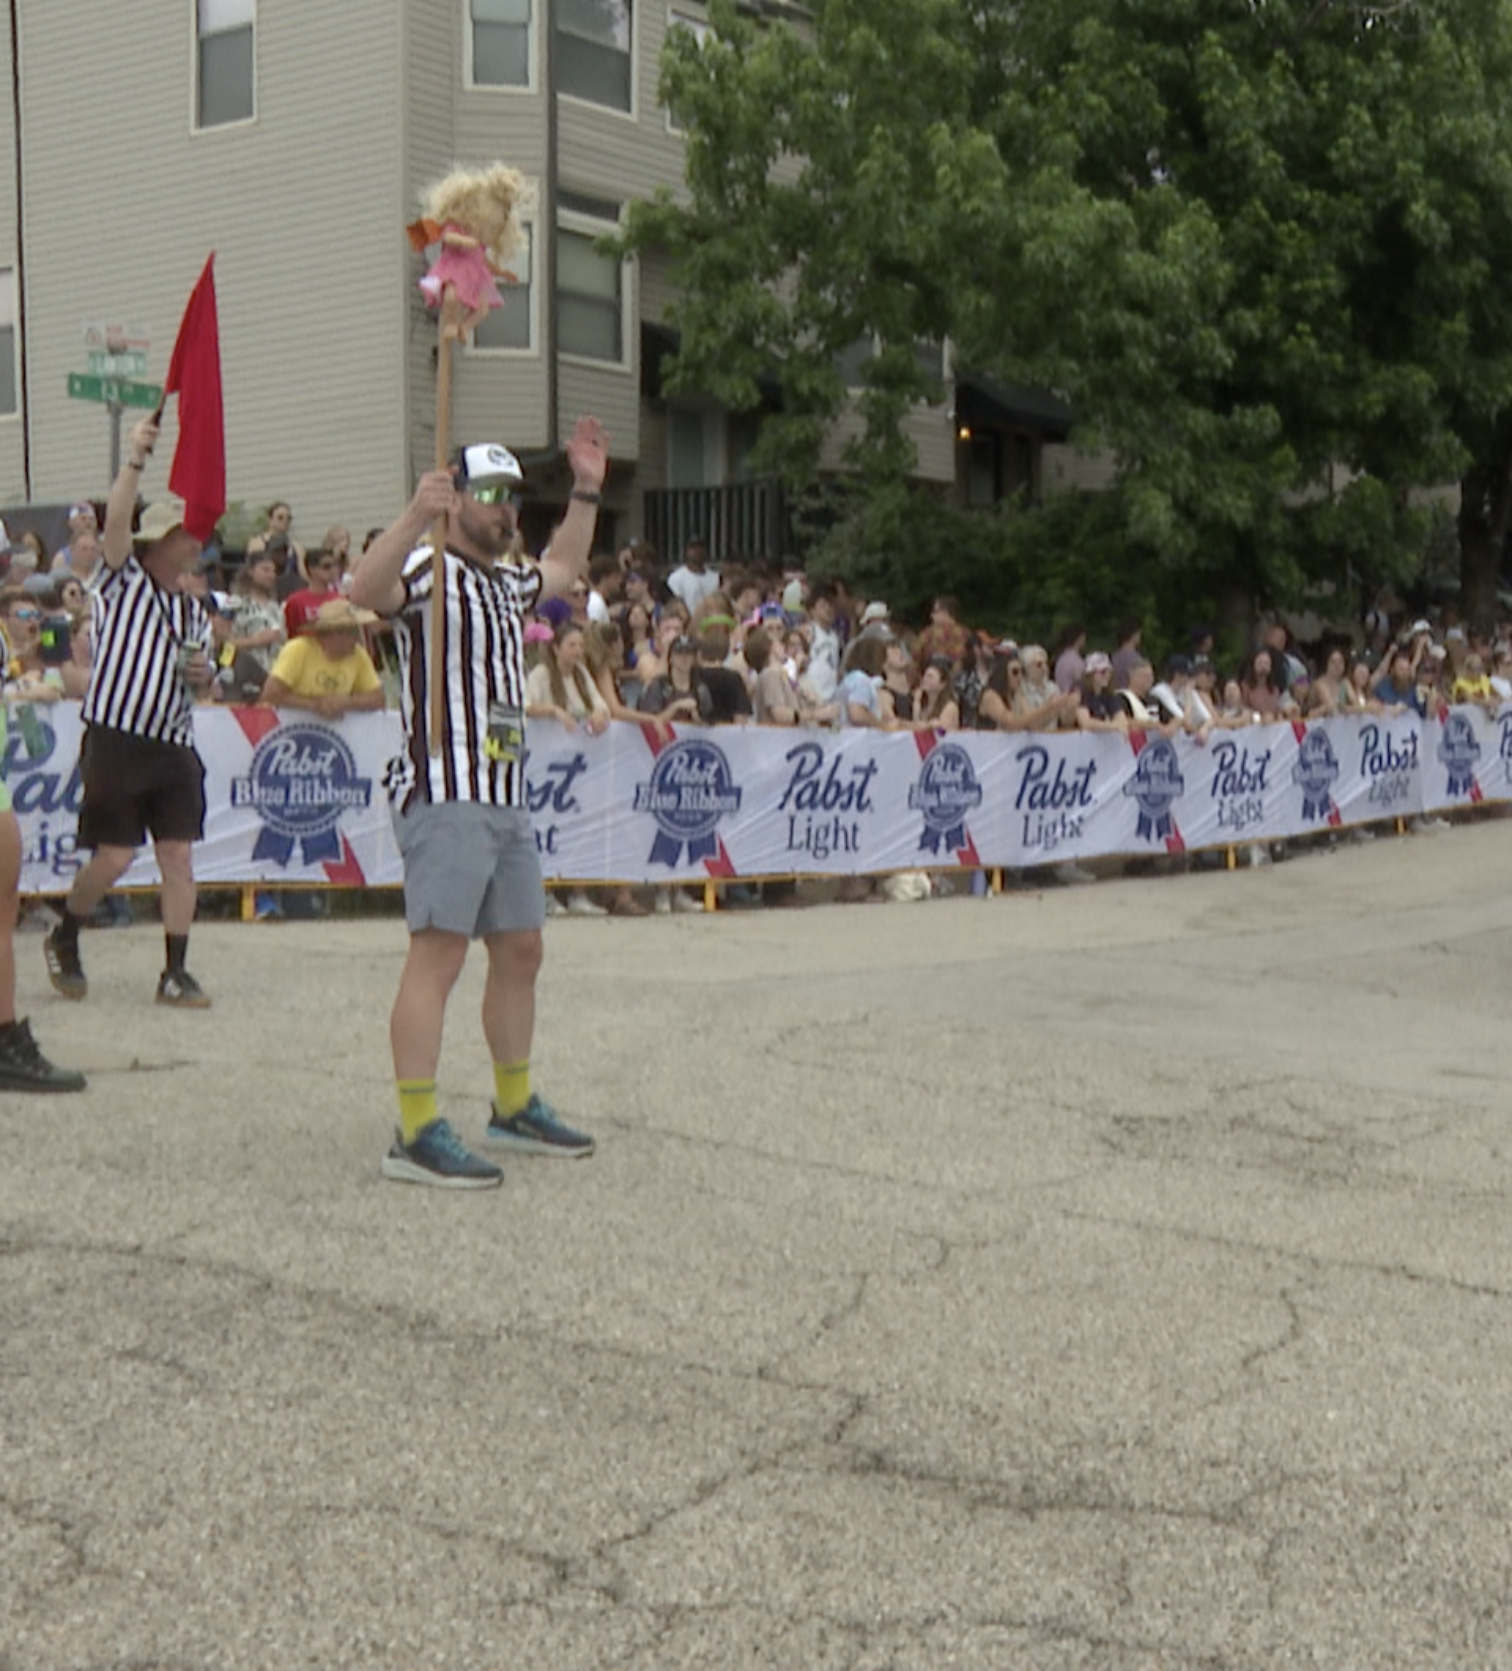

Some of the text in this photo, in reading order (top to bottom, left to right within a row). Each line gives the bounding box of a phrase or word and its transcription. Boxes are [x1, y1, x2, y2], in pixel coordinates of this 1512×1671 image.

[1, 720, 84, 814] Pab
[267, 737, 338, 776] Pabst
[1211, 740, 1271, 797] Pabst
[1359, 724, 1418, 777] Pabst
[235, 778, 367, 806] Blue Ribbon
[778, 742, 877, 813] Pabst
[1015, 745, 1097, 811] Pabst
[787, 815, 861, 859] Light
[1022, 815, 1083, 851] Light
